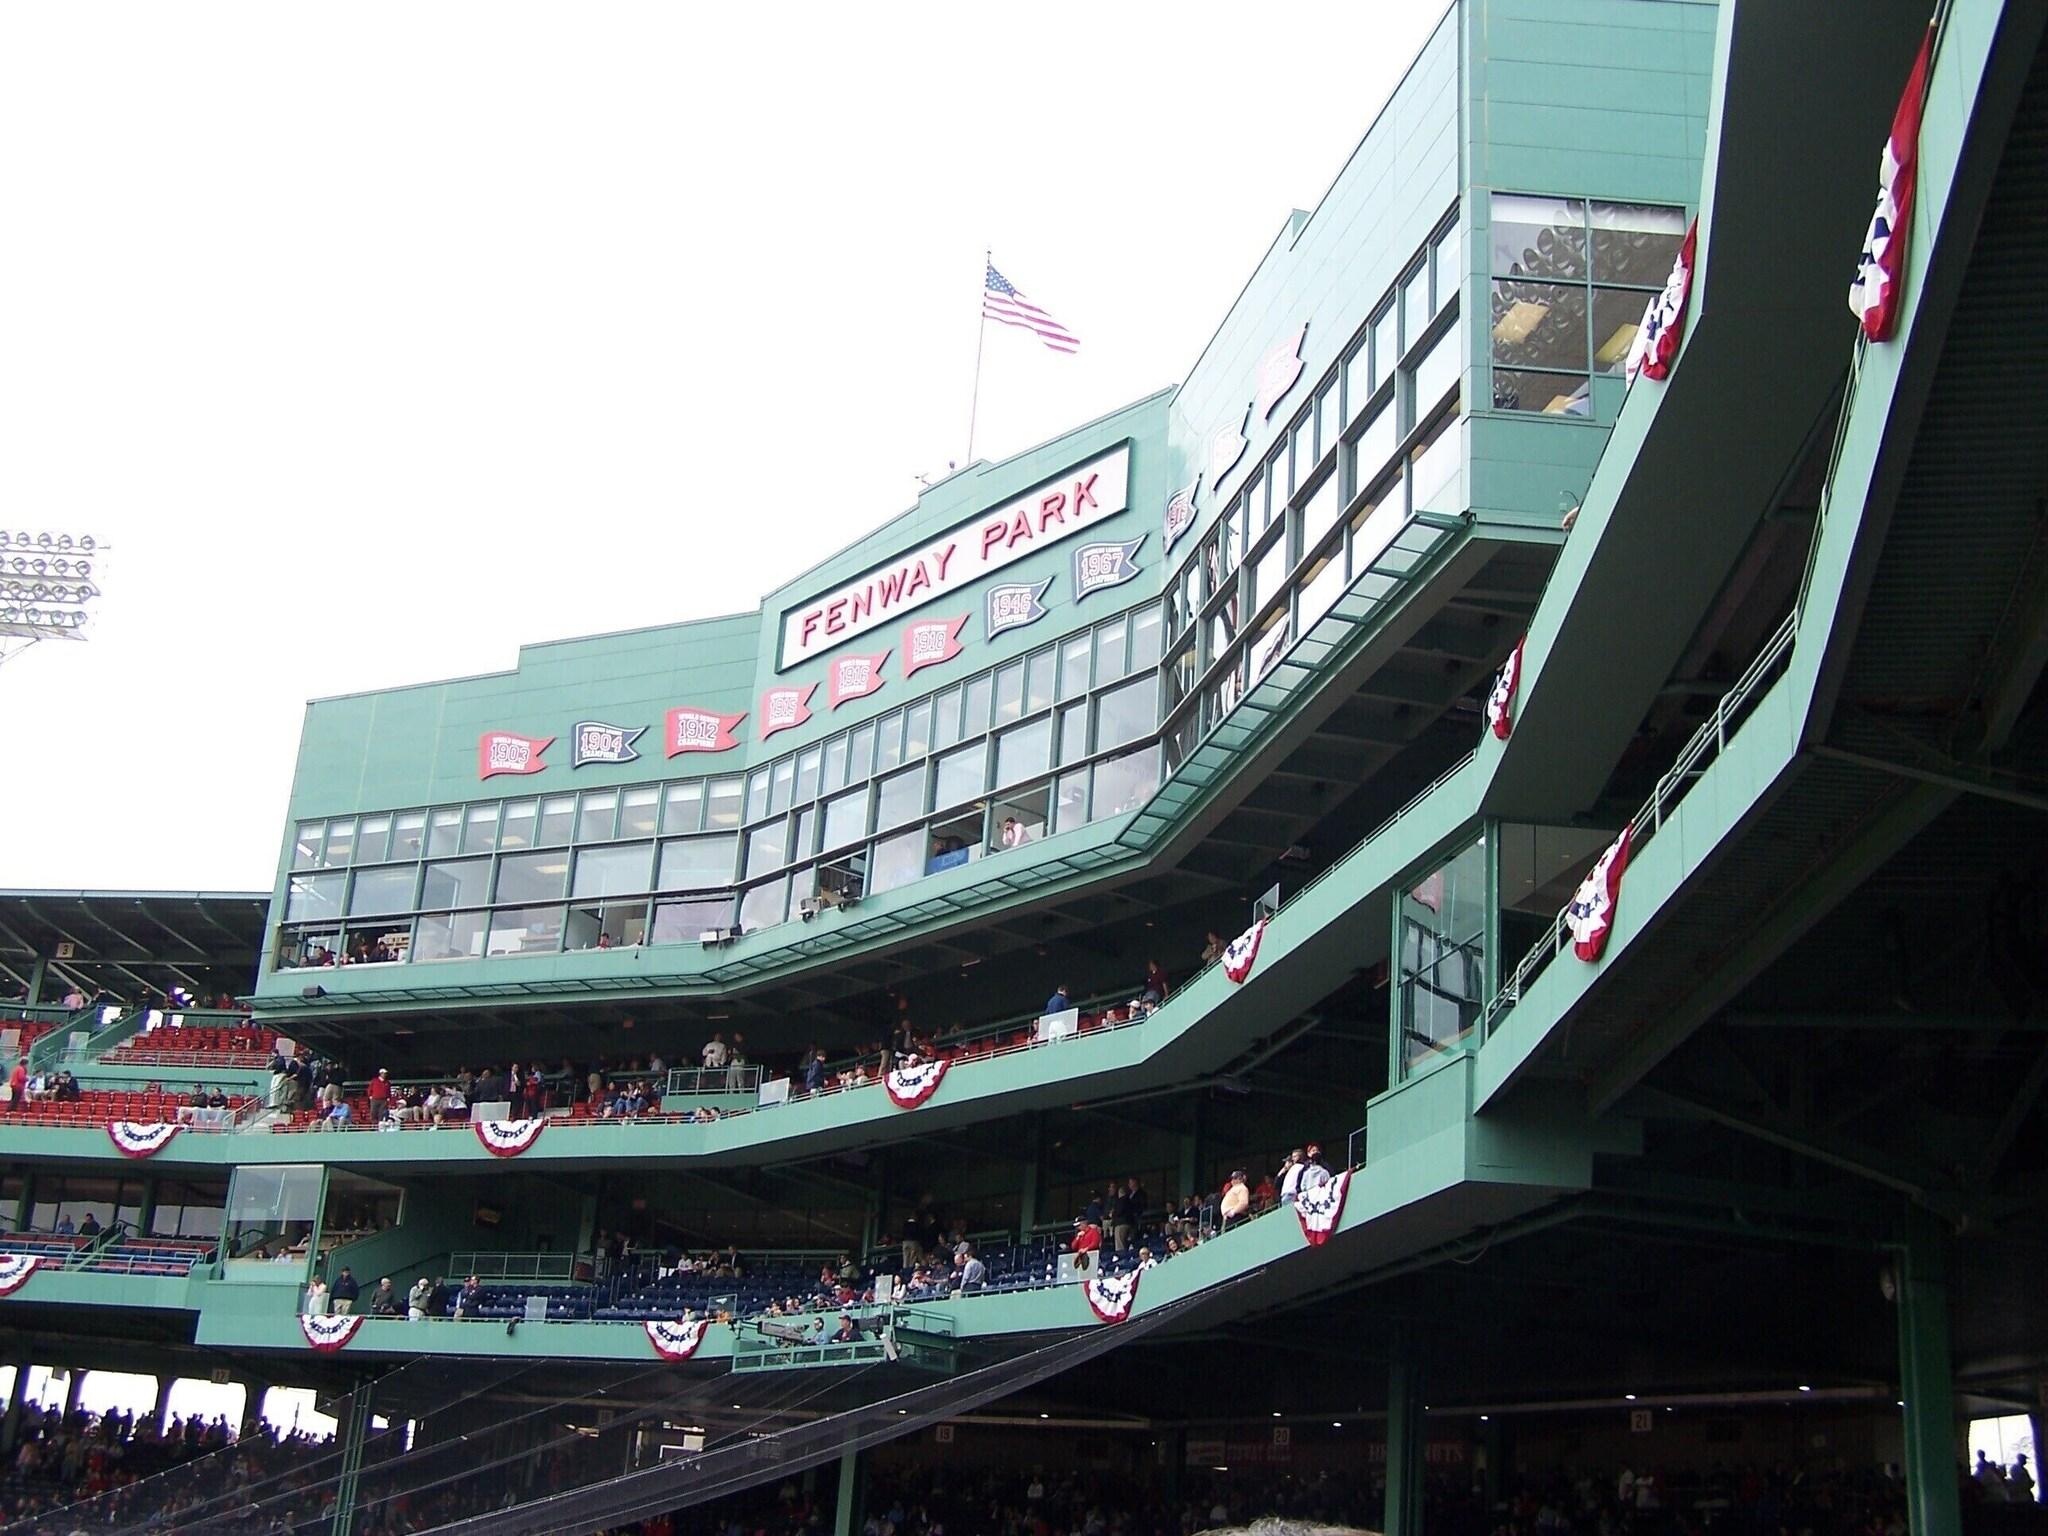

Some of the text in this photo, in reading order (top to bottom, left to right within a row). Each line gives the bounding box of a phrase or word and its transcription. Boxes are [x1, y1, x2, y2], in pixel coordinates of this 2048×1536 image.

[801, 473, 1099, 647] FENWAY PARK
[1081, 551, 1124, 581] 1967
[993, 593, 1032, 621] 1946
[912, 631, 946, 657] 1918
[838, 664, 871, 690] 1916
[678, 719, 719, 741] 1912
[490, 743, 530, 764] 1903
[580, 732, 623, 753] 1904
[62, 945, 69, 955] 3
[1635, 1414, 1648, 1429] 21
[1275, 1430, 1288, 1443] 20
